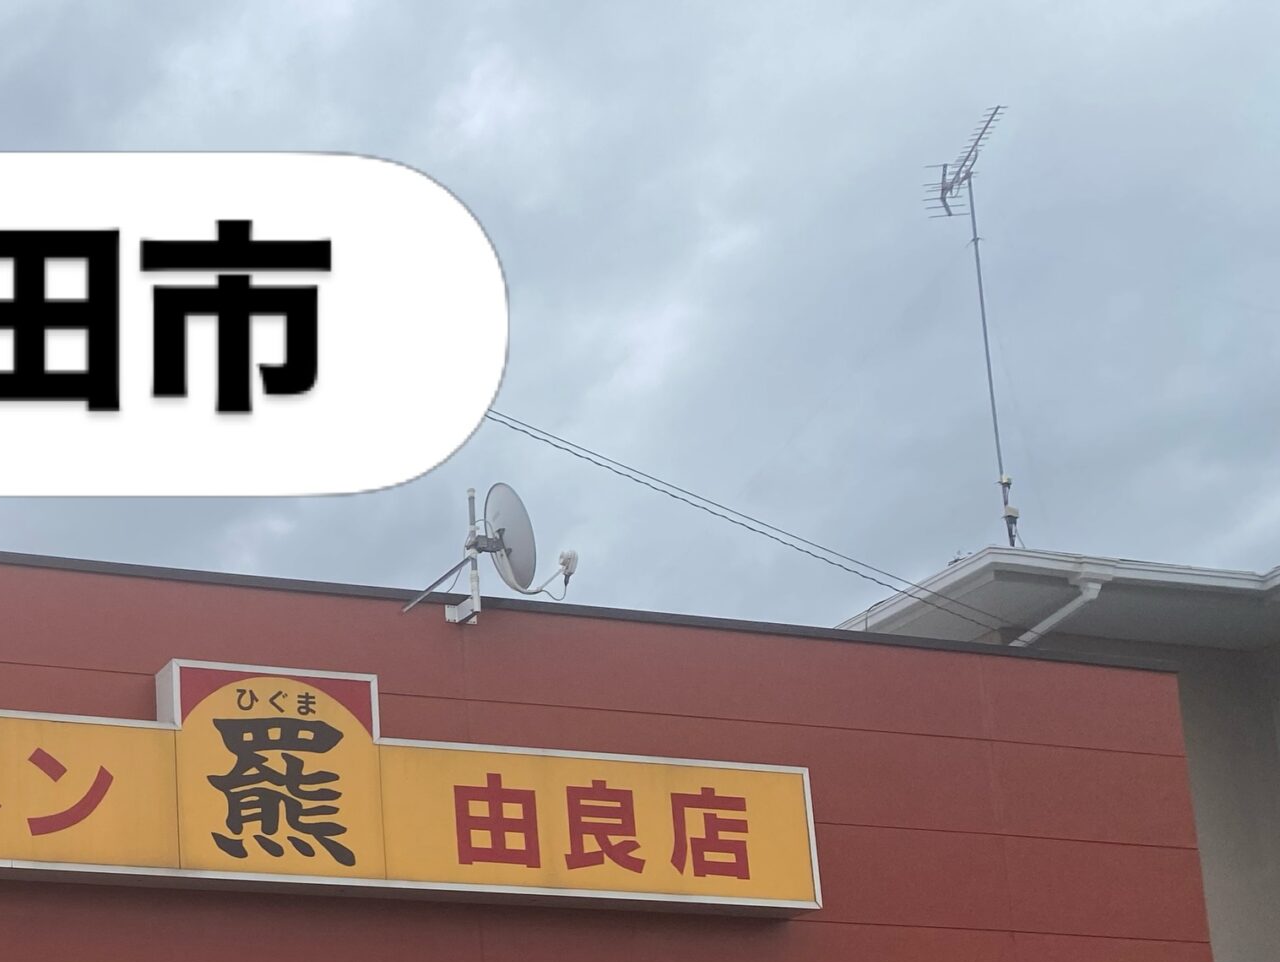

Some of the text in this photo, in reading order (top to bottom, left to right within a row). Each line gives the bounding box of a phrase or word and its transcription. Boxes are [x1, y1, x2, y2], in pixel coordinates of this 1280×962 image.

[236, 688, 316, 716] ひぐま
[206, 717, 356, 867] 羆
[453, 772, 752, 881] 由良店
